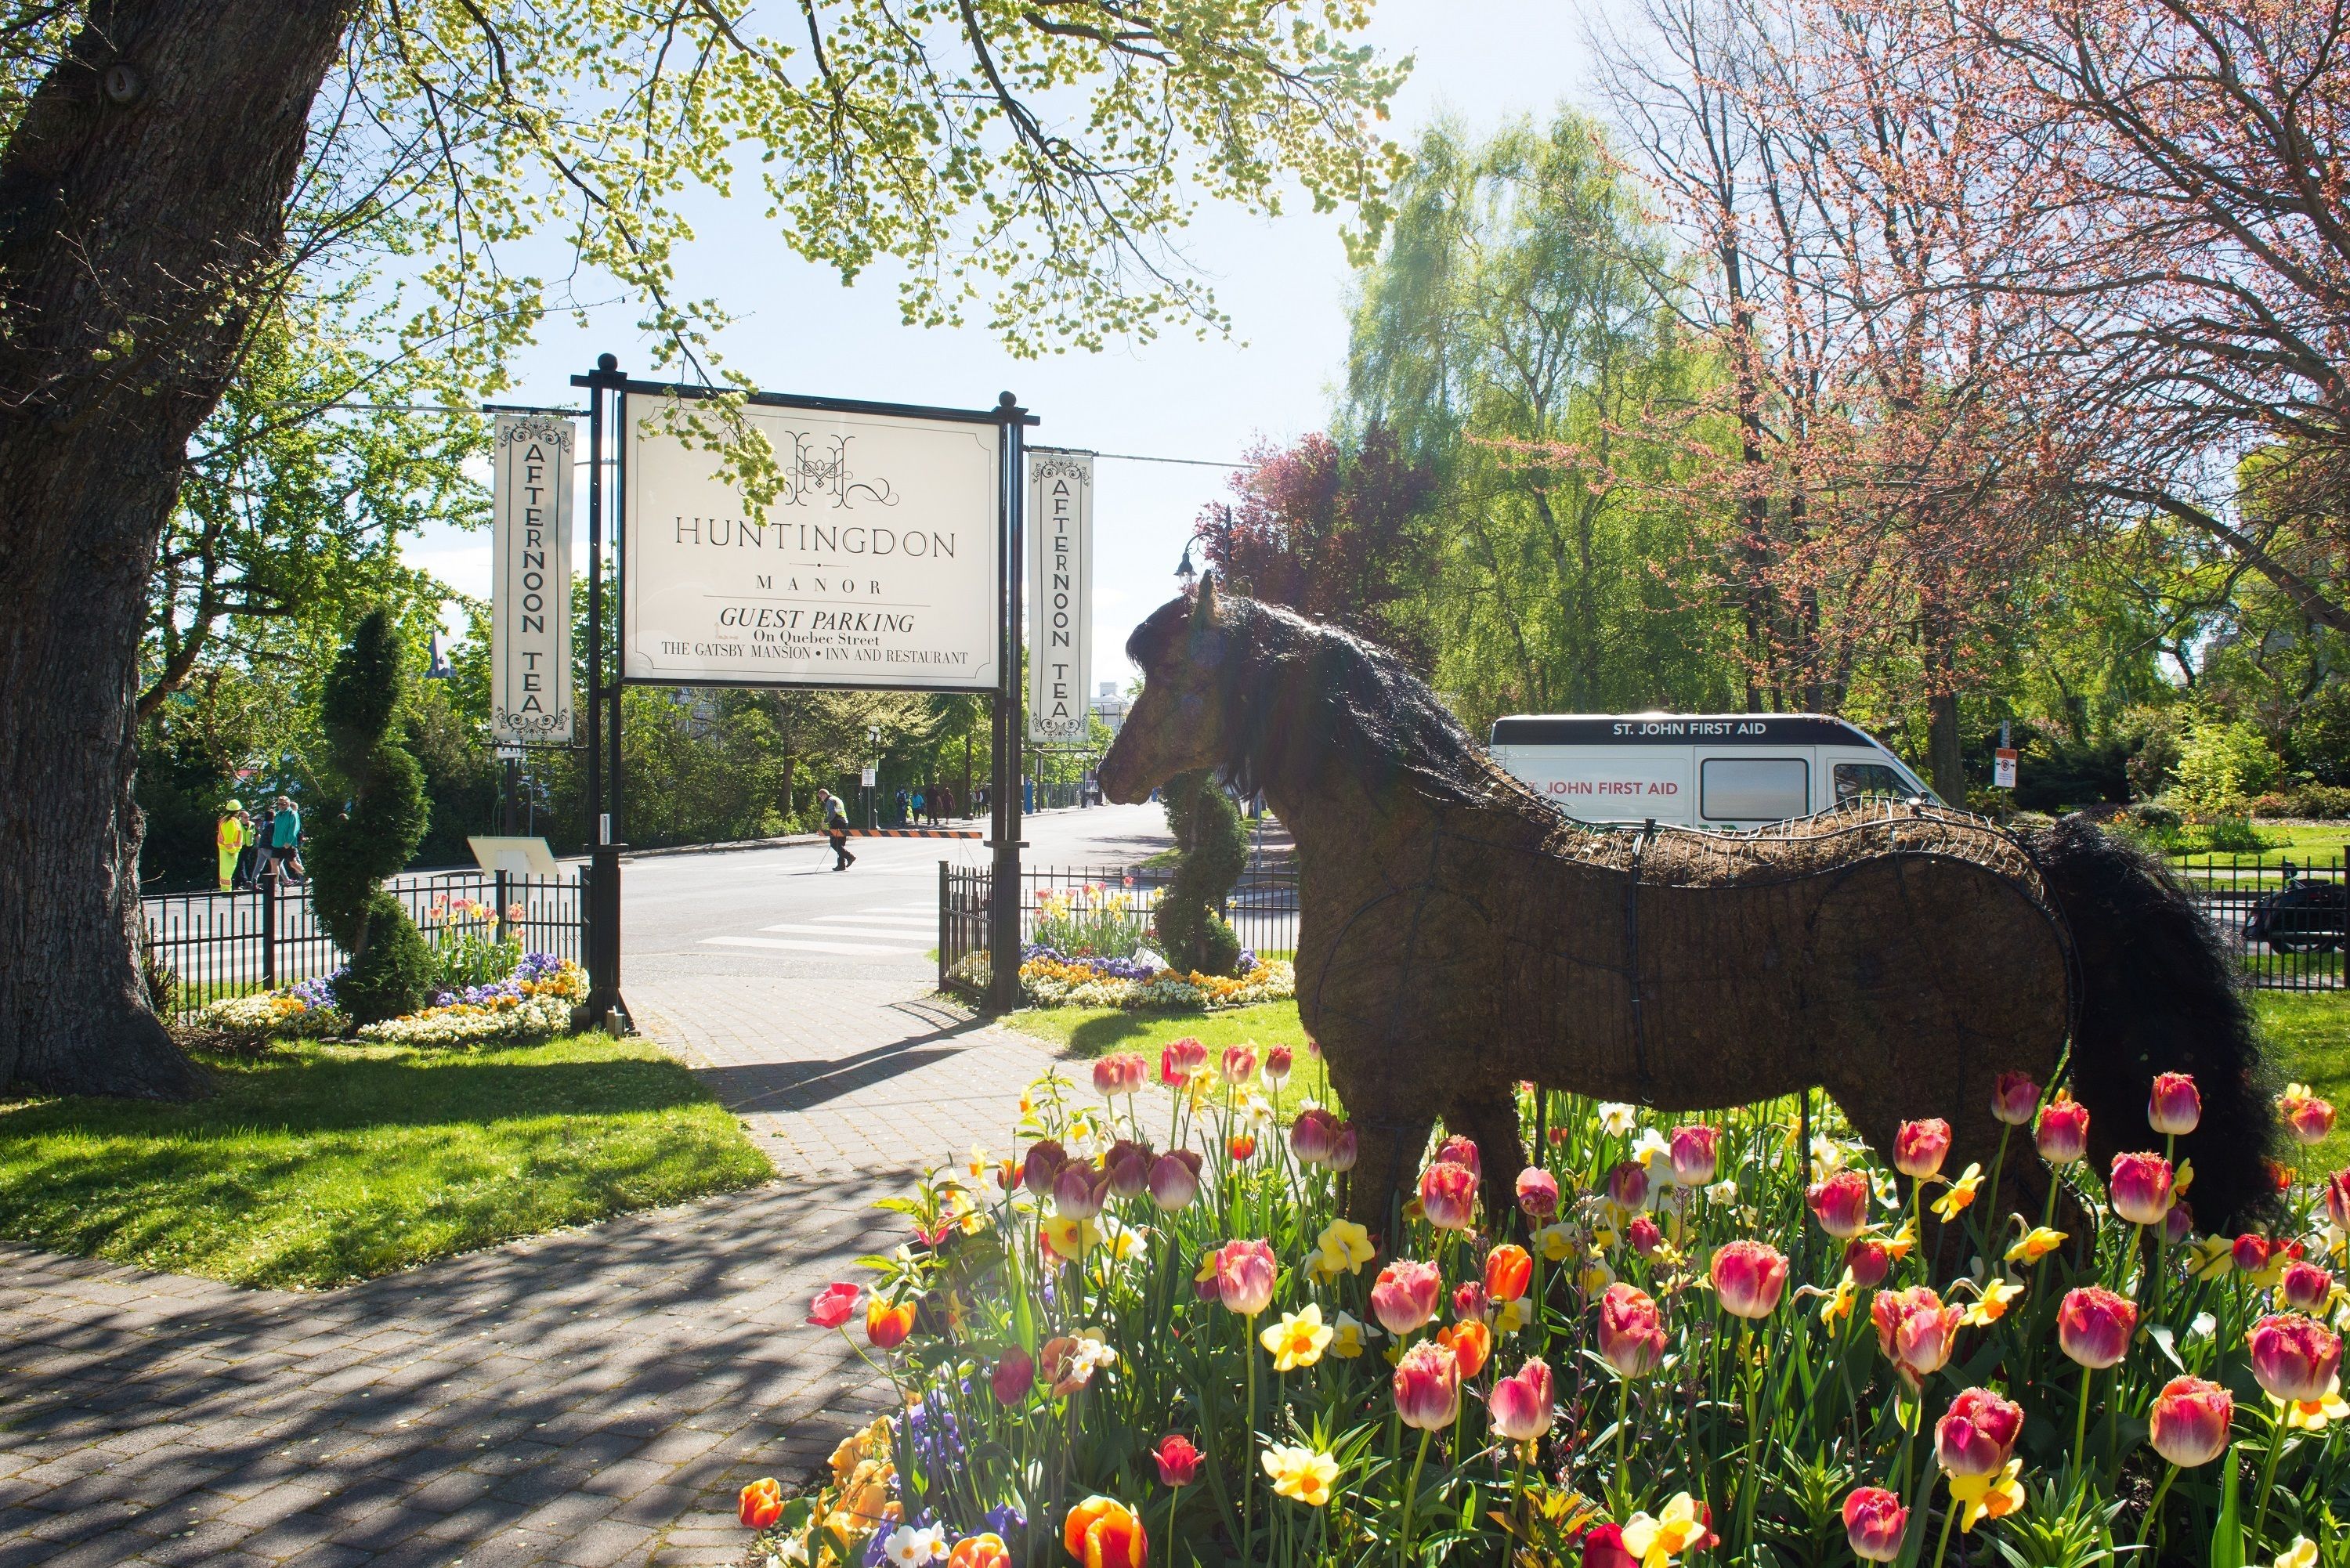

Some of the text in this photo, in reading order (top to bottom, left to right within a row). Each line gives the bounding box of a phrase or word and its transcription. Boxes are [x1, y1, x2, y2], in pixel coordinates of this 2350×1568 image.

[676, 517, 955, 558] HUNTINGDON
[521, 444, 545, 714] AFTERNOON TEA
[756, 575, 881, 594] MANOR
[1051, 479, 1070, 718] AFTERNOON TEA
[720, 607, 915, 633] GUEST PARKING
[754, 629, 880, 646] On Quebec Street
[661, 641, 969, 665] THE GATSBY MANSION INN AND RESTAURANT
[1613, 722, 1766, 735] ST. JOHN FIRST AID
[1598, 782, 1643, 794] FIRST
[1647, 782, 1678, 794] AID
